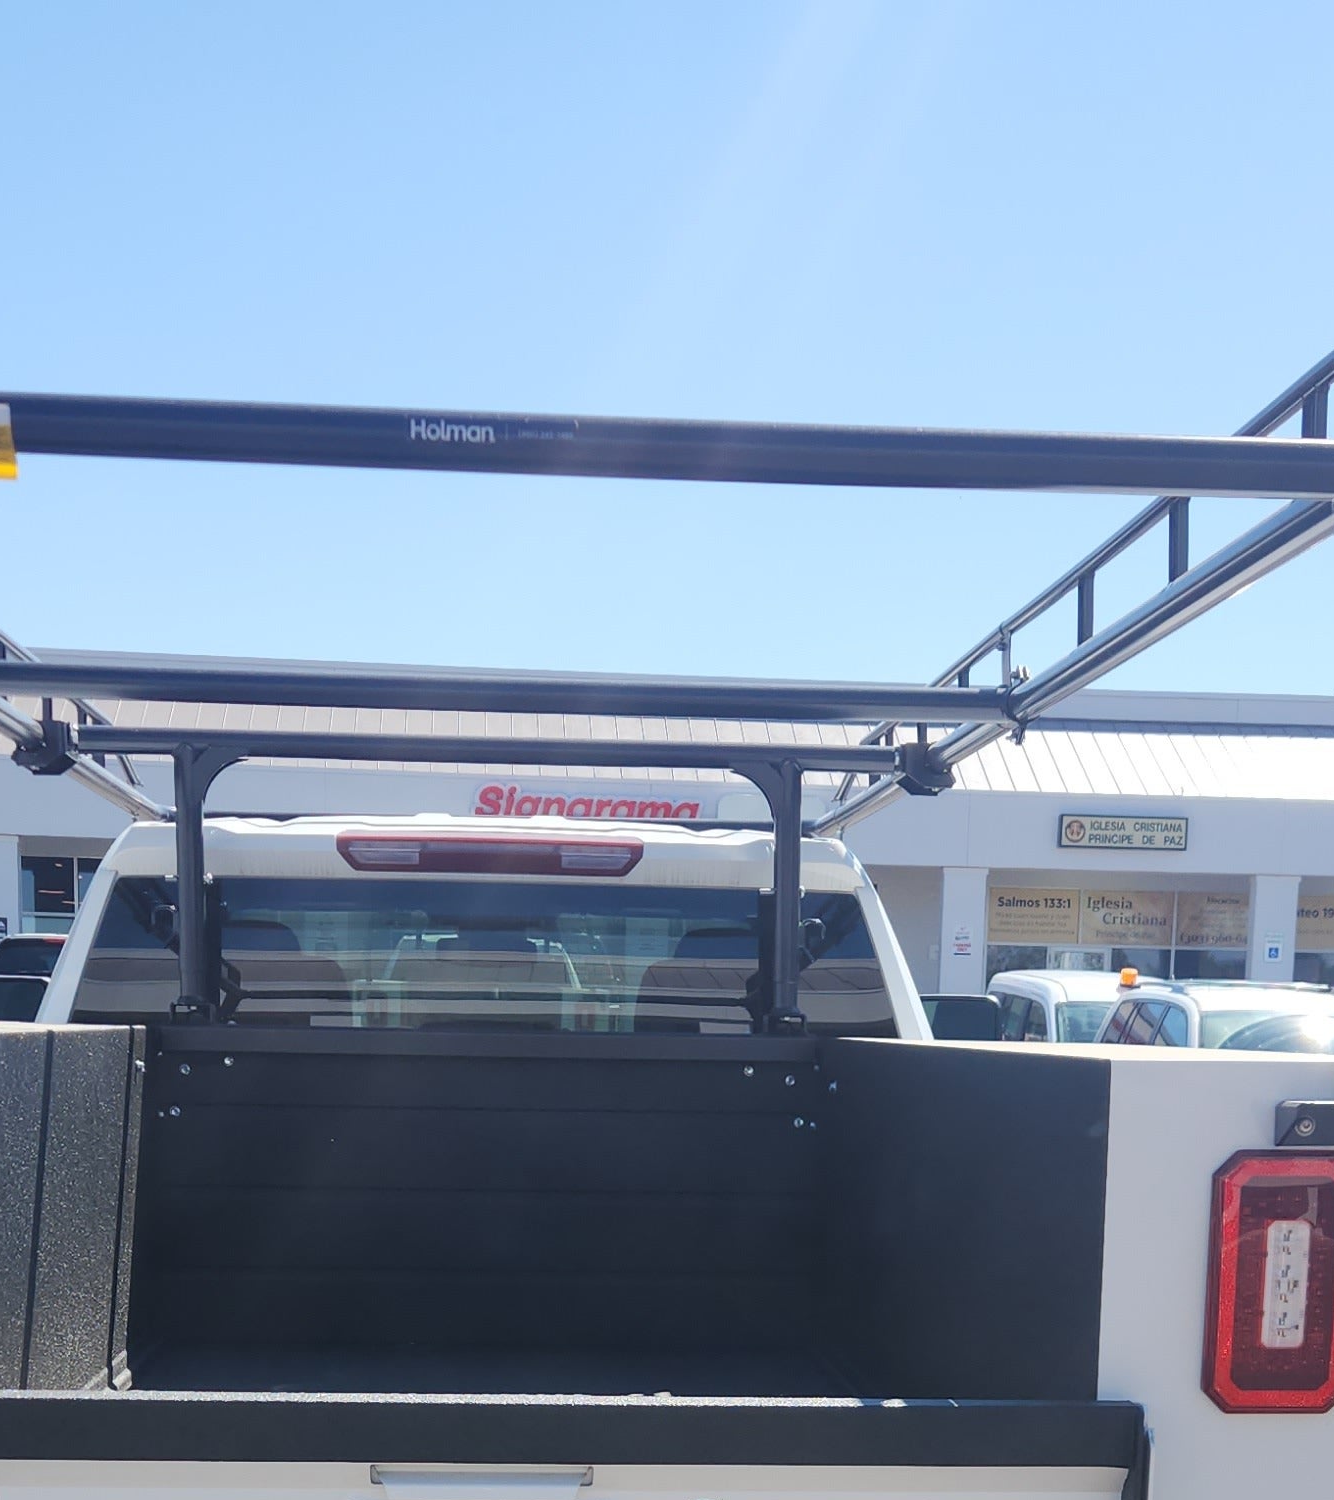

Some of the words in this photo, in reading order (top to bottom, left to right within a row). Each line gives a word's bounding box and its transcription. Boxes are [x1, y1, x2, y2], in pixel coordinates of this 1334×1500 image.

[409, 418, 496, 444] Holman
[474, 785, 701, 819] Signarama
[1089, 820, 1127, 832] IGLESIA
[1133, 822, 1183, 833] CRISTIANA
[1087, 833, 1134, 844] PRINCIPE
[1141, 835, 1156, 845] DE
[1163, 836, 1184, 846] PAZ
[996, 896, 1041, 909] Salmos
[1044, 898, 1072, 909] 133:1
[1086, 897, 1133, 912] Iglesia
[1102, 912, 1168, 926] Cristiana
